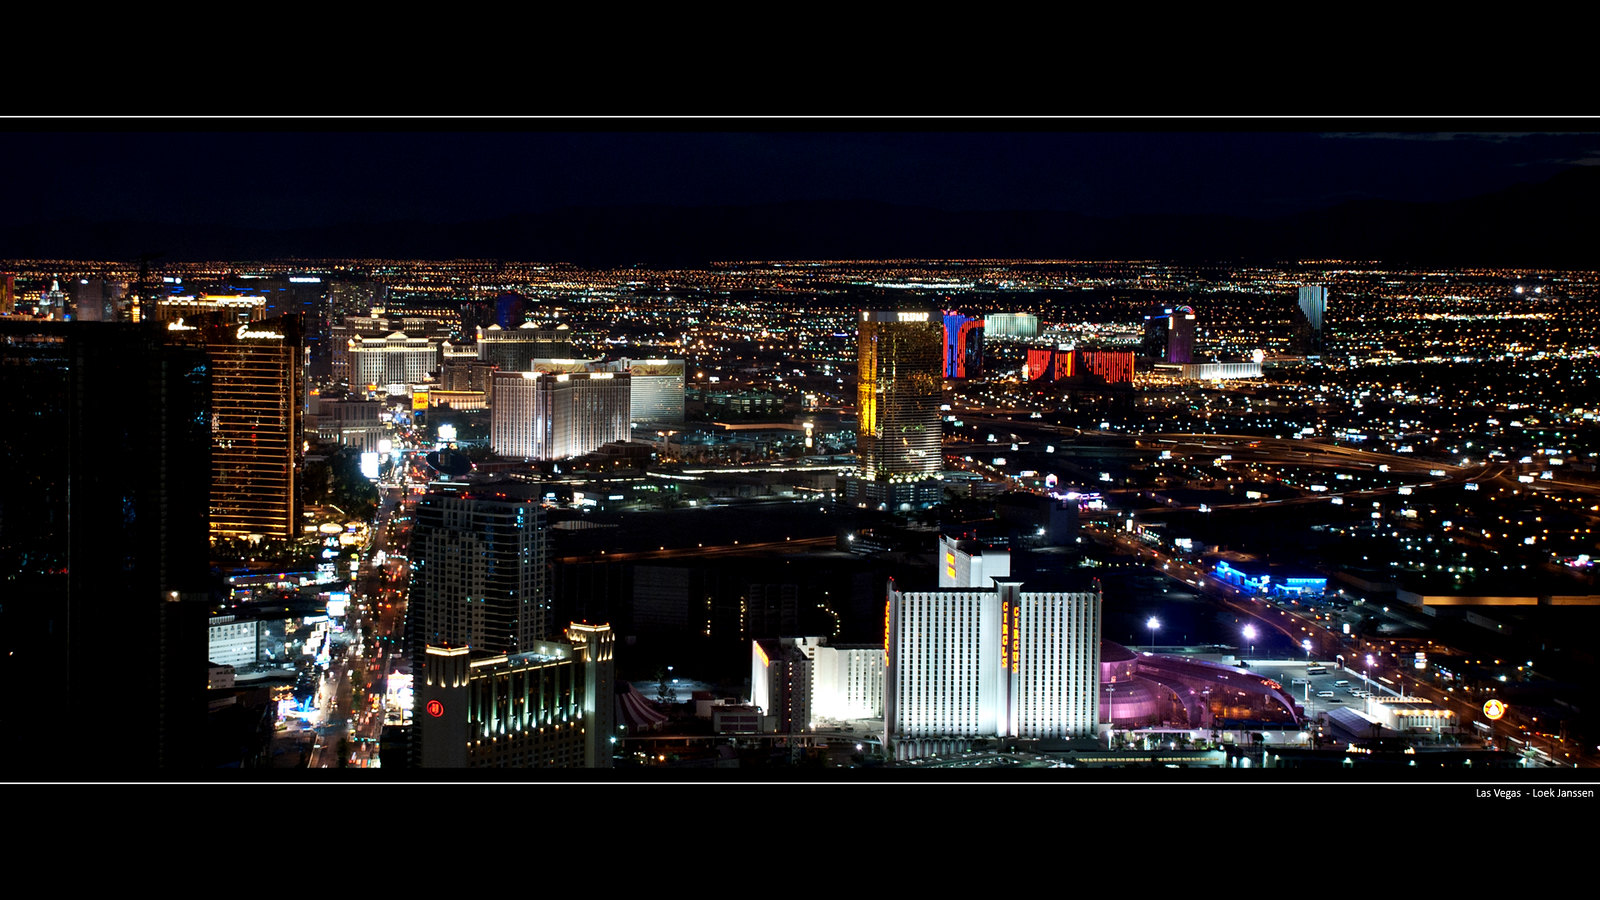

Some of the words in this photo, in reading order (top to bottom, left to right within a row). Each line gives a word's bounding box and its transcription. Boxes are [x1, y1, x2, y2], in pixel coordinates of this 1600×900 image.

[897, 311, 930, 322] TRUMP
[236, 324, 285, 340] Encore
[1012, 606, 1020, 674] CIRCUS
